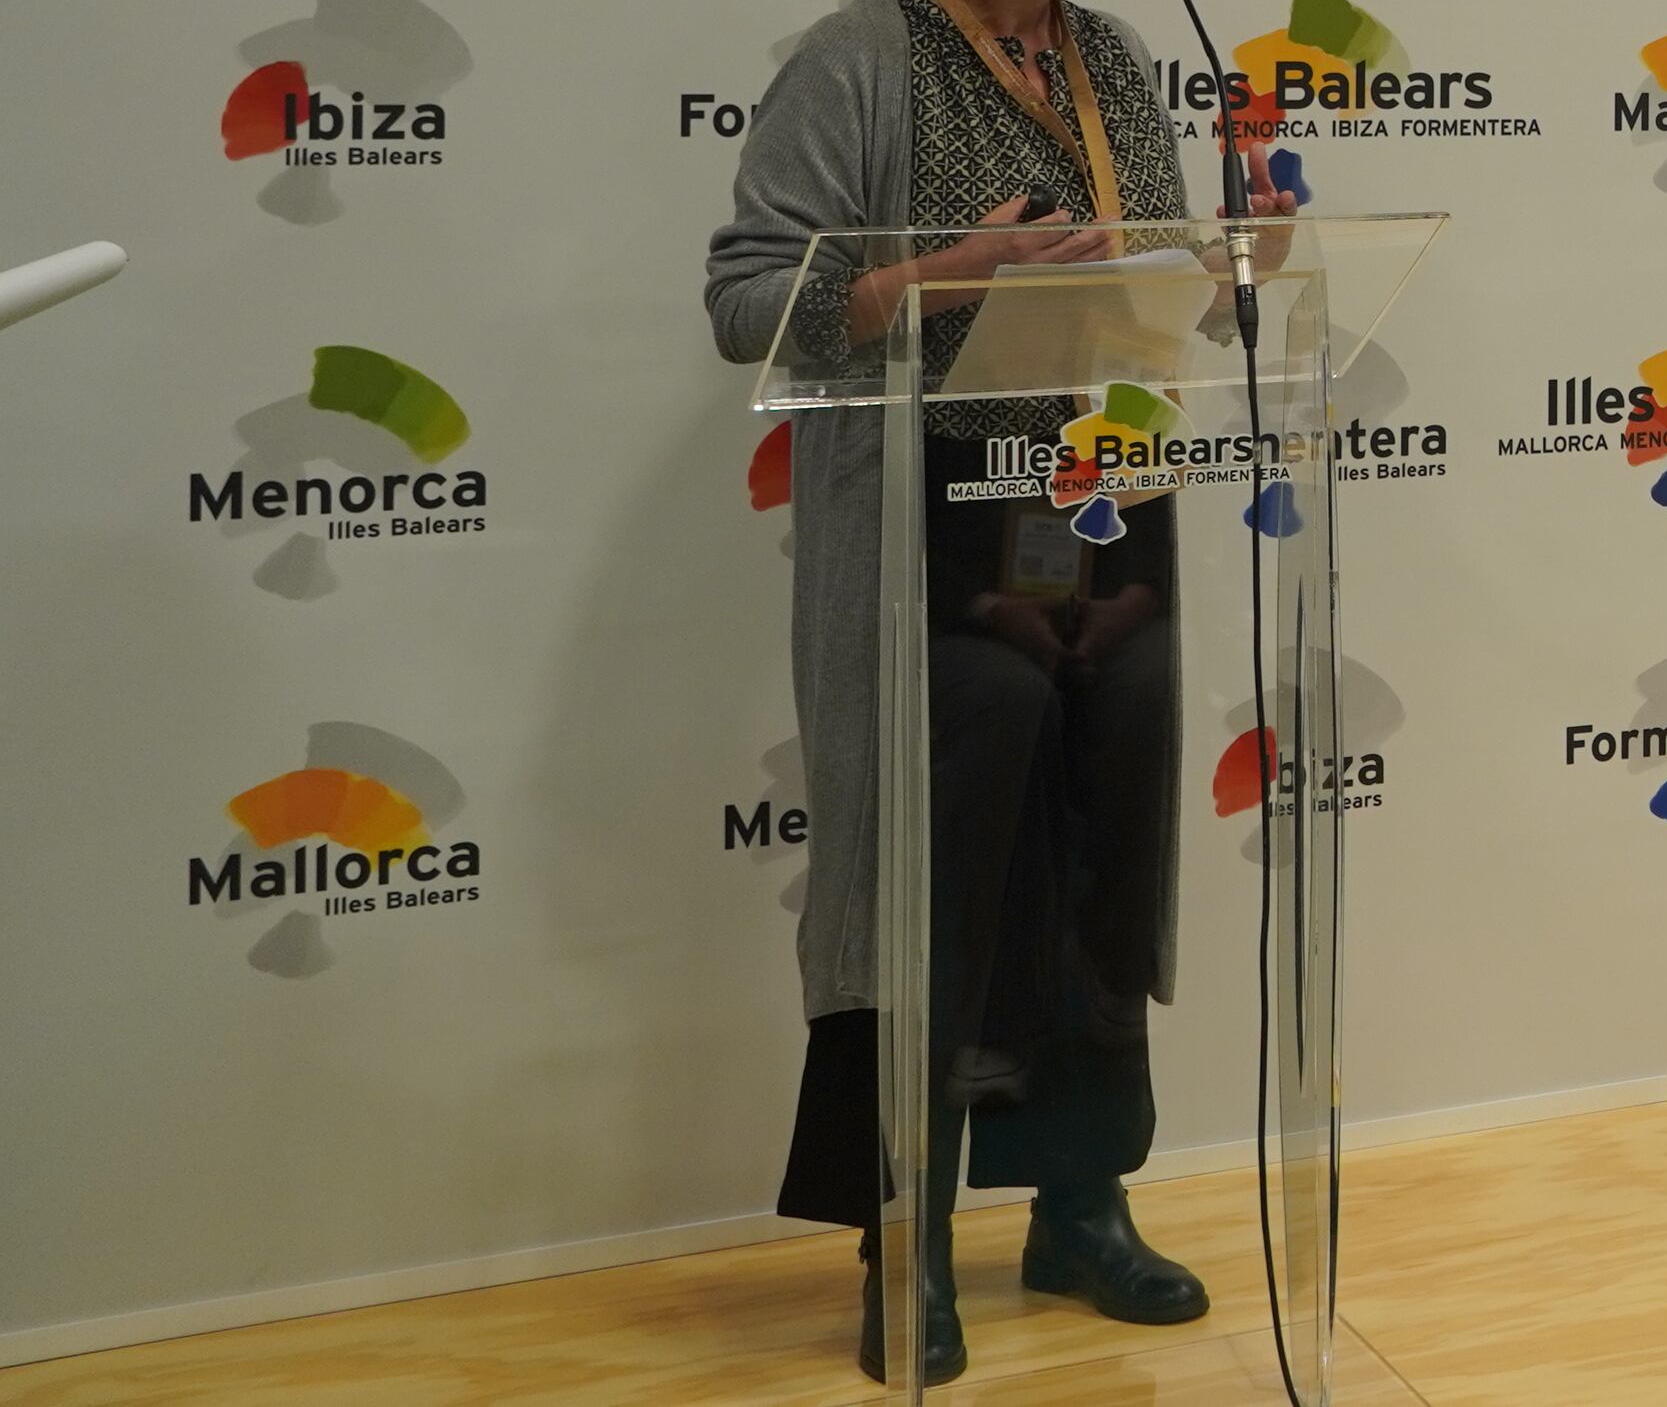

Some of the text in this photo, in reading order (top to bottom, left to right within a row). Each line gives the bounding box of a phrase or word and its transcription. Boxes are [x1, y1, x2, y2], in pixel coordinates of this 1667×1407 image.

[1274, 57, 1493, 111] Balears
[283, 91, 446, 141] Ibiza
[1332, 119, 1389, 138] IBIZA
[1401, 118, 1542, 137] FORMENTERA
[285, 146, 443, 167] Illes Balears
[1547, 376, 1656, 427] Illes
[989, 431, 1253, 477] Illes Balears
[1498, 433, 1609, 456] MALLORCA
[950, 466, 1290, 499] MALLORCA MENORCA IBIZA FORMENERA
[1337, 462, 1447, 482] lles Balears
[189, 470, 487, 523] Menorca
[328, 516, 486, 540] Illes Balears
[188, 841, 480, 906] Mallorca
[325, 886, 480, 917] Illes Balears
